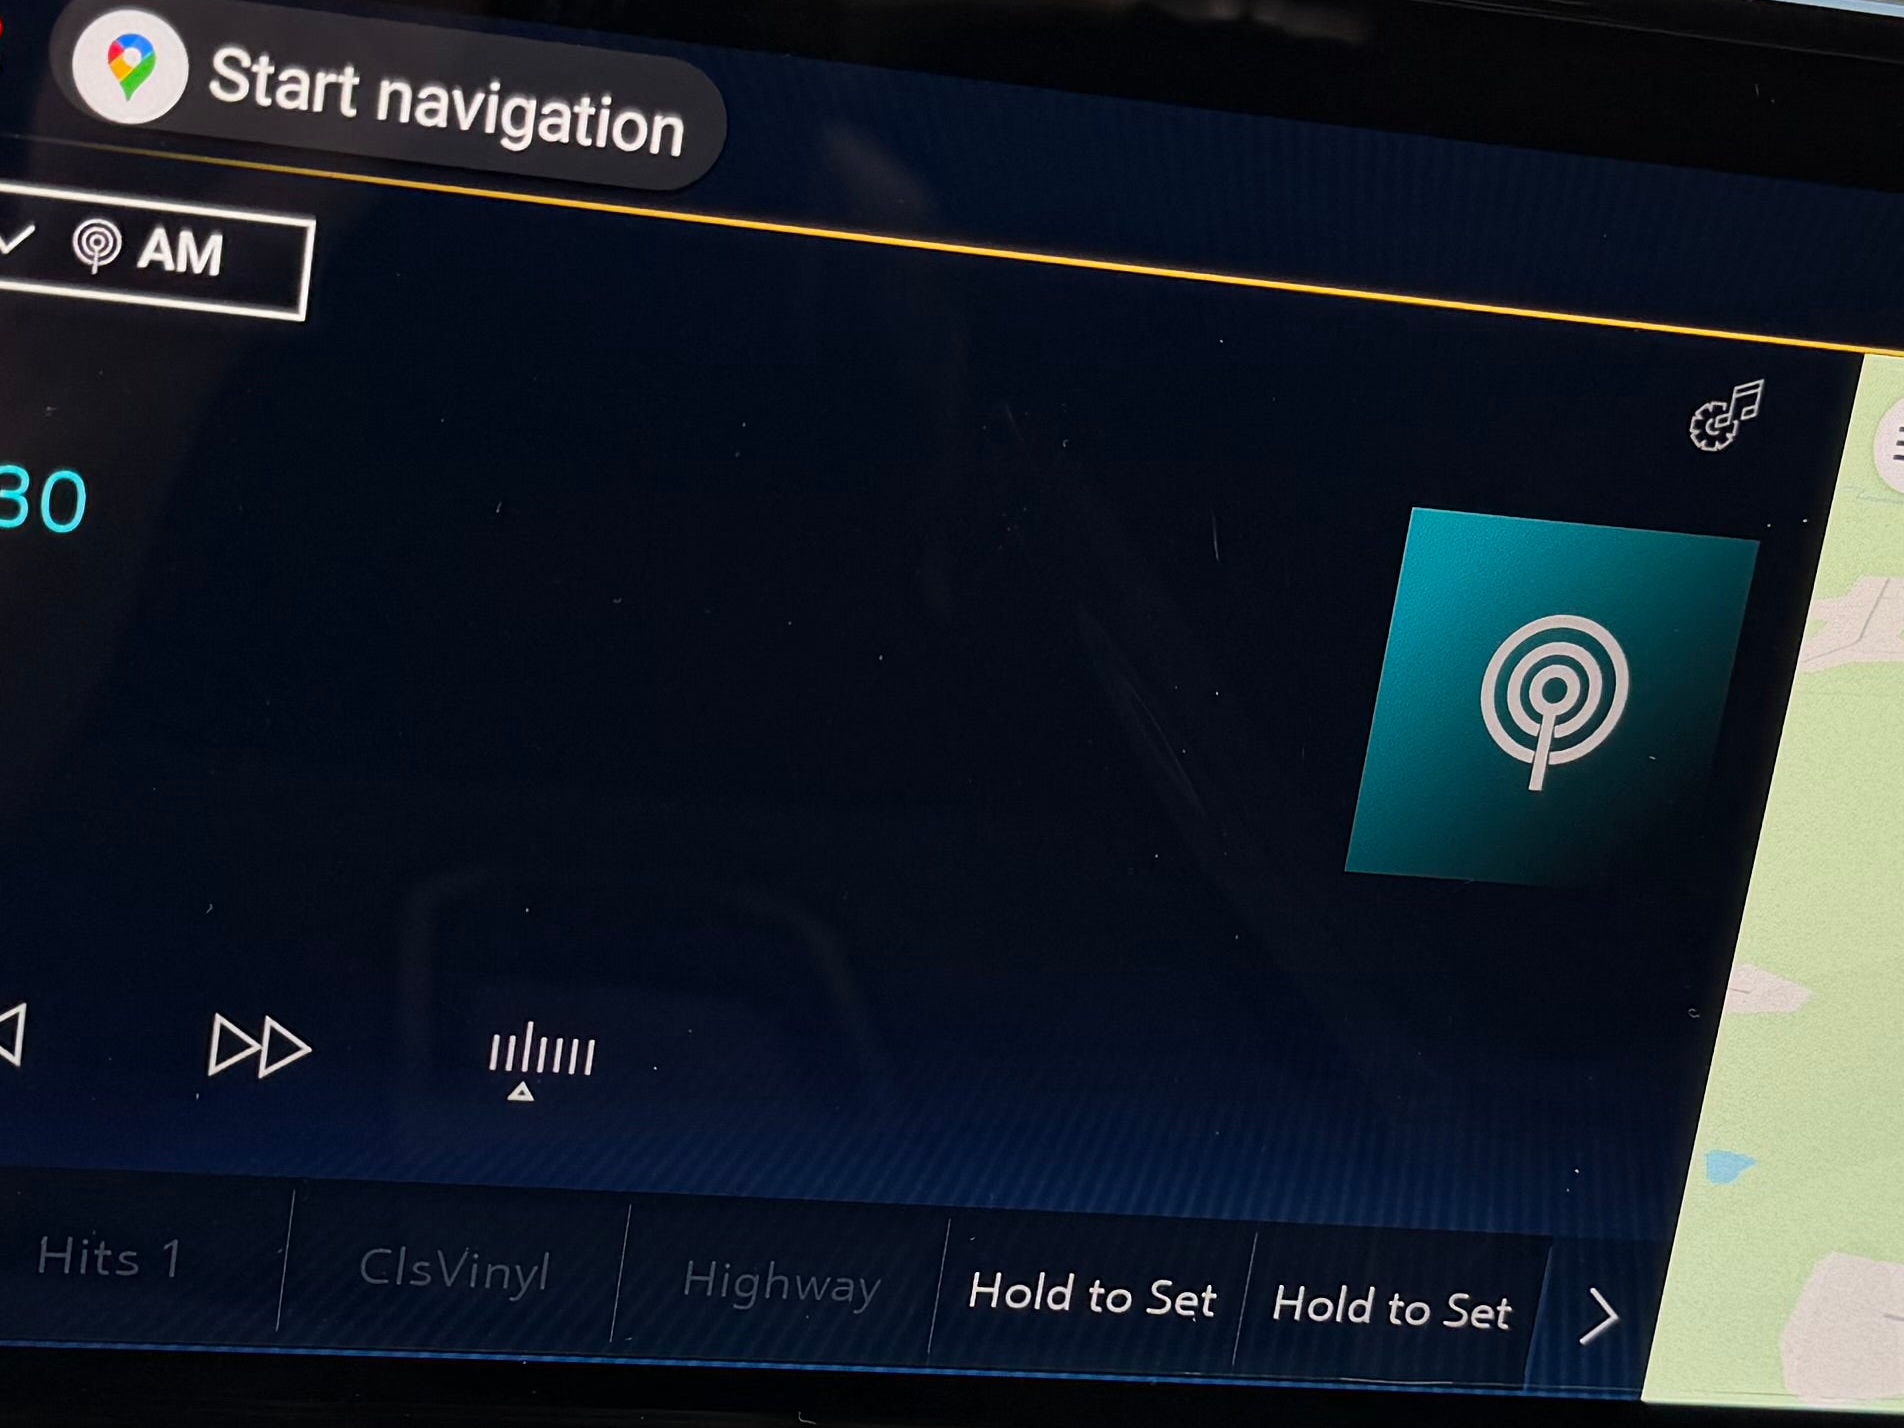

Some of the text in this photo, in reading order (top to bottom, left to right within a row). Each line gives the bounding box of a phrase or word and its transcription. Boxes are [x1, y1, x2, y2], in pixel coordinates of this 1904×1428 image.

[208, 44, 685, 158] Start navigation
[136, 227, 224, 278] AM
[38, 1235, 180, 1278] Hits 1
[360, 1245, 551, 1302] ClsVinyl
[684, 1260, 882, 1315] Highway
[968, 1271, 1218, 1318] Hold to Set
[1272, 1283, 1514, 1331] Hold to Set
